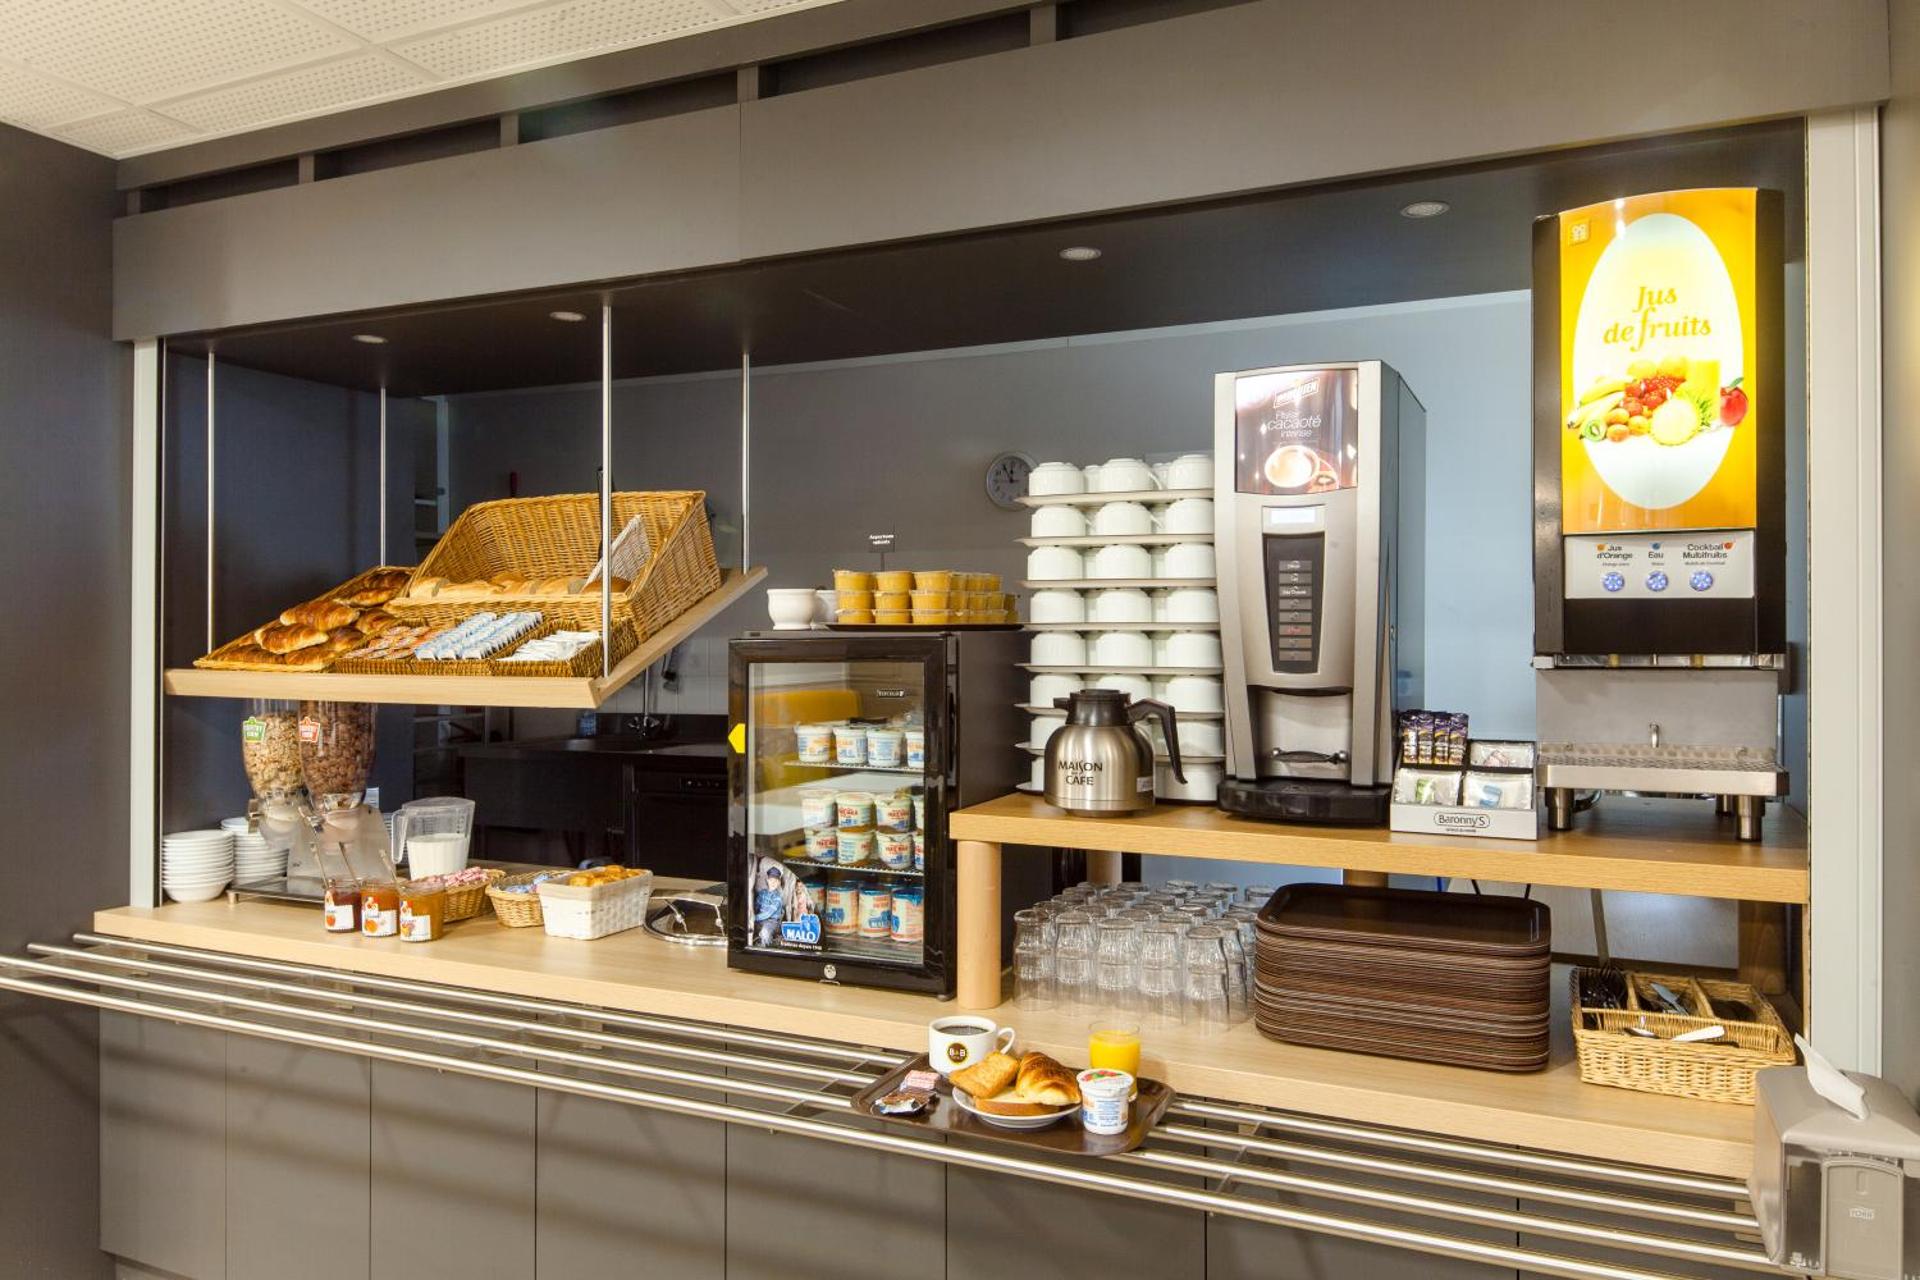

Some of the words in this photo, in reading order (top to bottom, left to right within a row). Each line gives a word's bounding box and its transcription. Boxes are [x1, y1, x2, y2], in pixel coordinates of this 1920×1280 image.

[1632, 286, 1677, 313] Jus
[1604, 322, 1634, 344] de
[1629, 306, 1711, 352] fruits
[1687, 543, 1724, 551] Cocktail
[1596, 552, 1633, 560] d'Orange
[1648, 551, 1664, 559] Eau
[1058, 760, 1103, 772] MAISON
[786, 928, 816, 942] MALO
